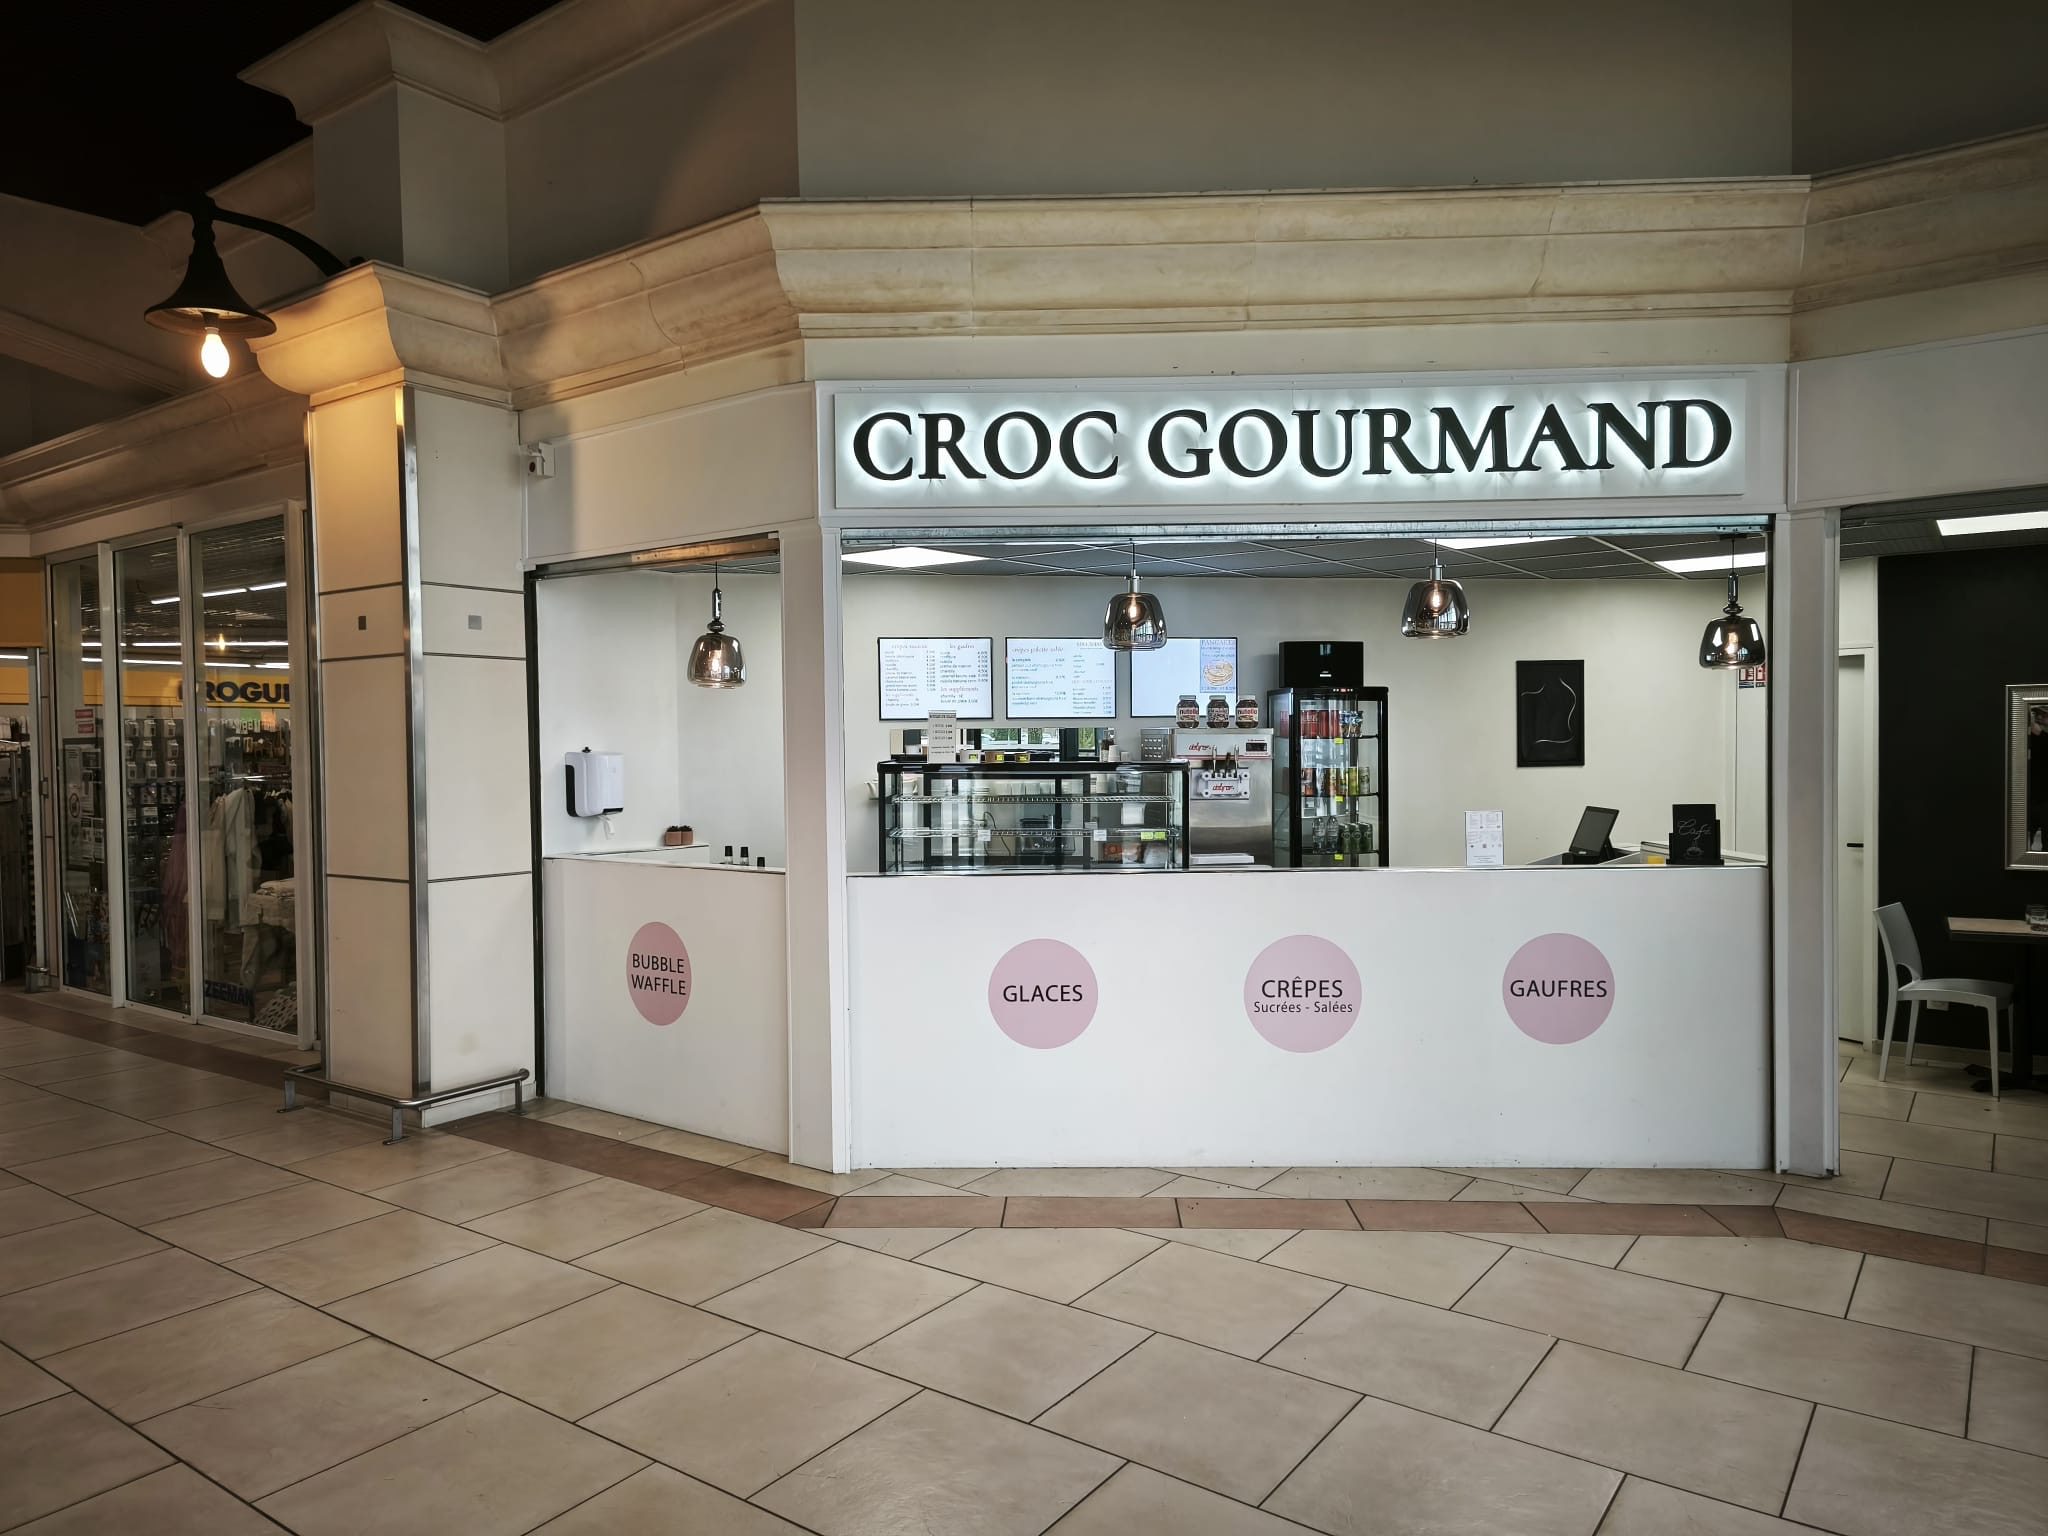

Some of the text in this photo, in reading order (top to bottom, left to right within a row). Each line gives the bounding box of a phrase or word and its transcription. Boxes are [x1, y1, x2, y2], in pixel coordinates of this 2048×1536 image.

[852, 397, 1733, 481] CROC GOURMAND
[178, 680, 290, 703] ROGU
[632, 953, 685, 974] BUBBLE
[631, 973, 687, 996] WAFFLE
[1003, 984, 1083, 1003] GLACES
[1261, 975, 1343, 998] CRÊPES
[1509, 979, 1608, 998] GAUFRES
[1253, 1000, 1302, 1013] Sucrées
[1313, 1000, 1353, 1013] Salées
